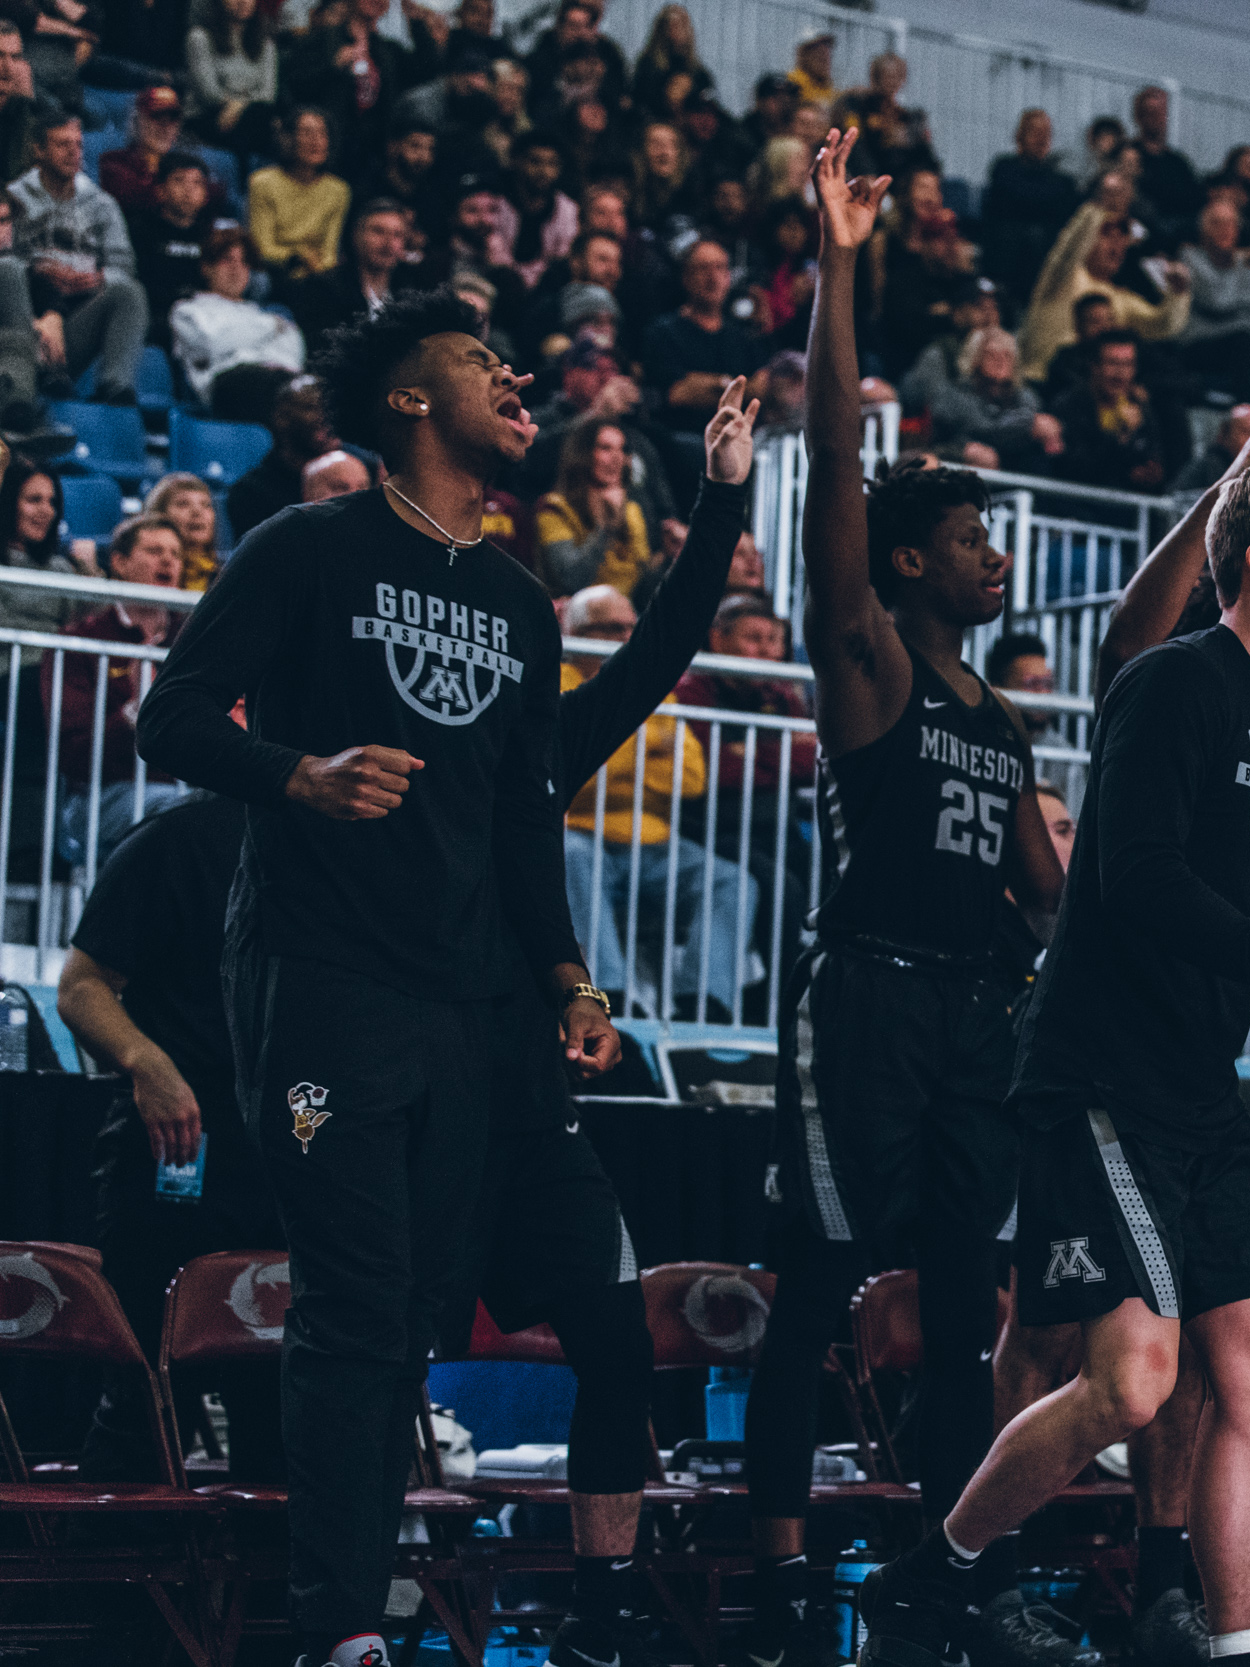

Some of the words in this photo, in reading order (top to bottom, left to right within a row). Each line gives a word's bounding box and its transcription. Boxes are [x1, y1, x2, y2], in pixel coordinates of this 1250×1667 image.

[364, 620, 514, 675] BASKETBALL
[375, 582, 508, 653] GOPHER
[935, 779, 1009, 866] 25
